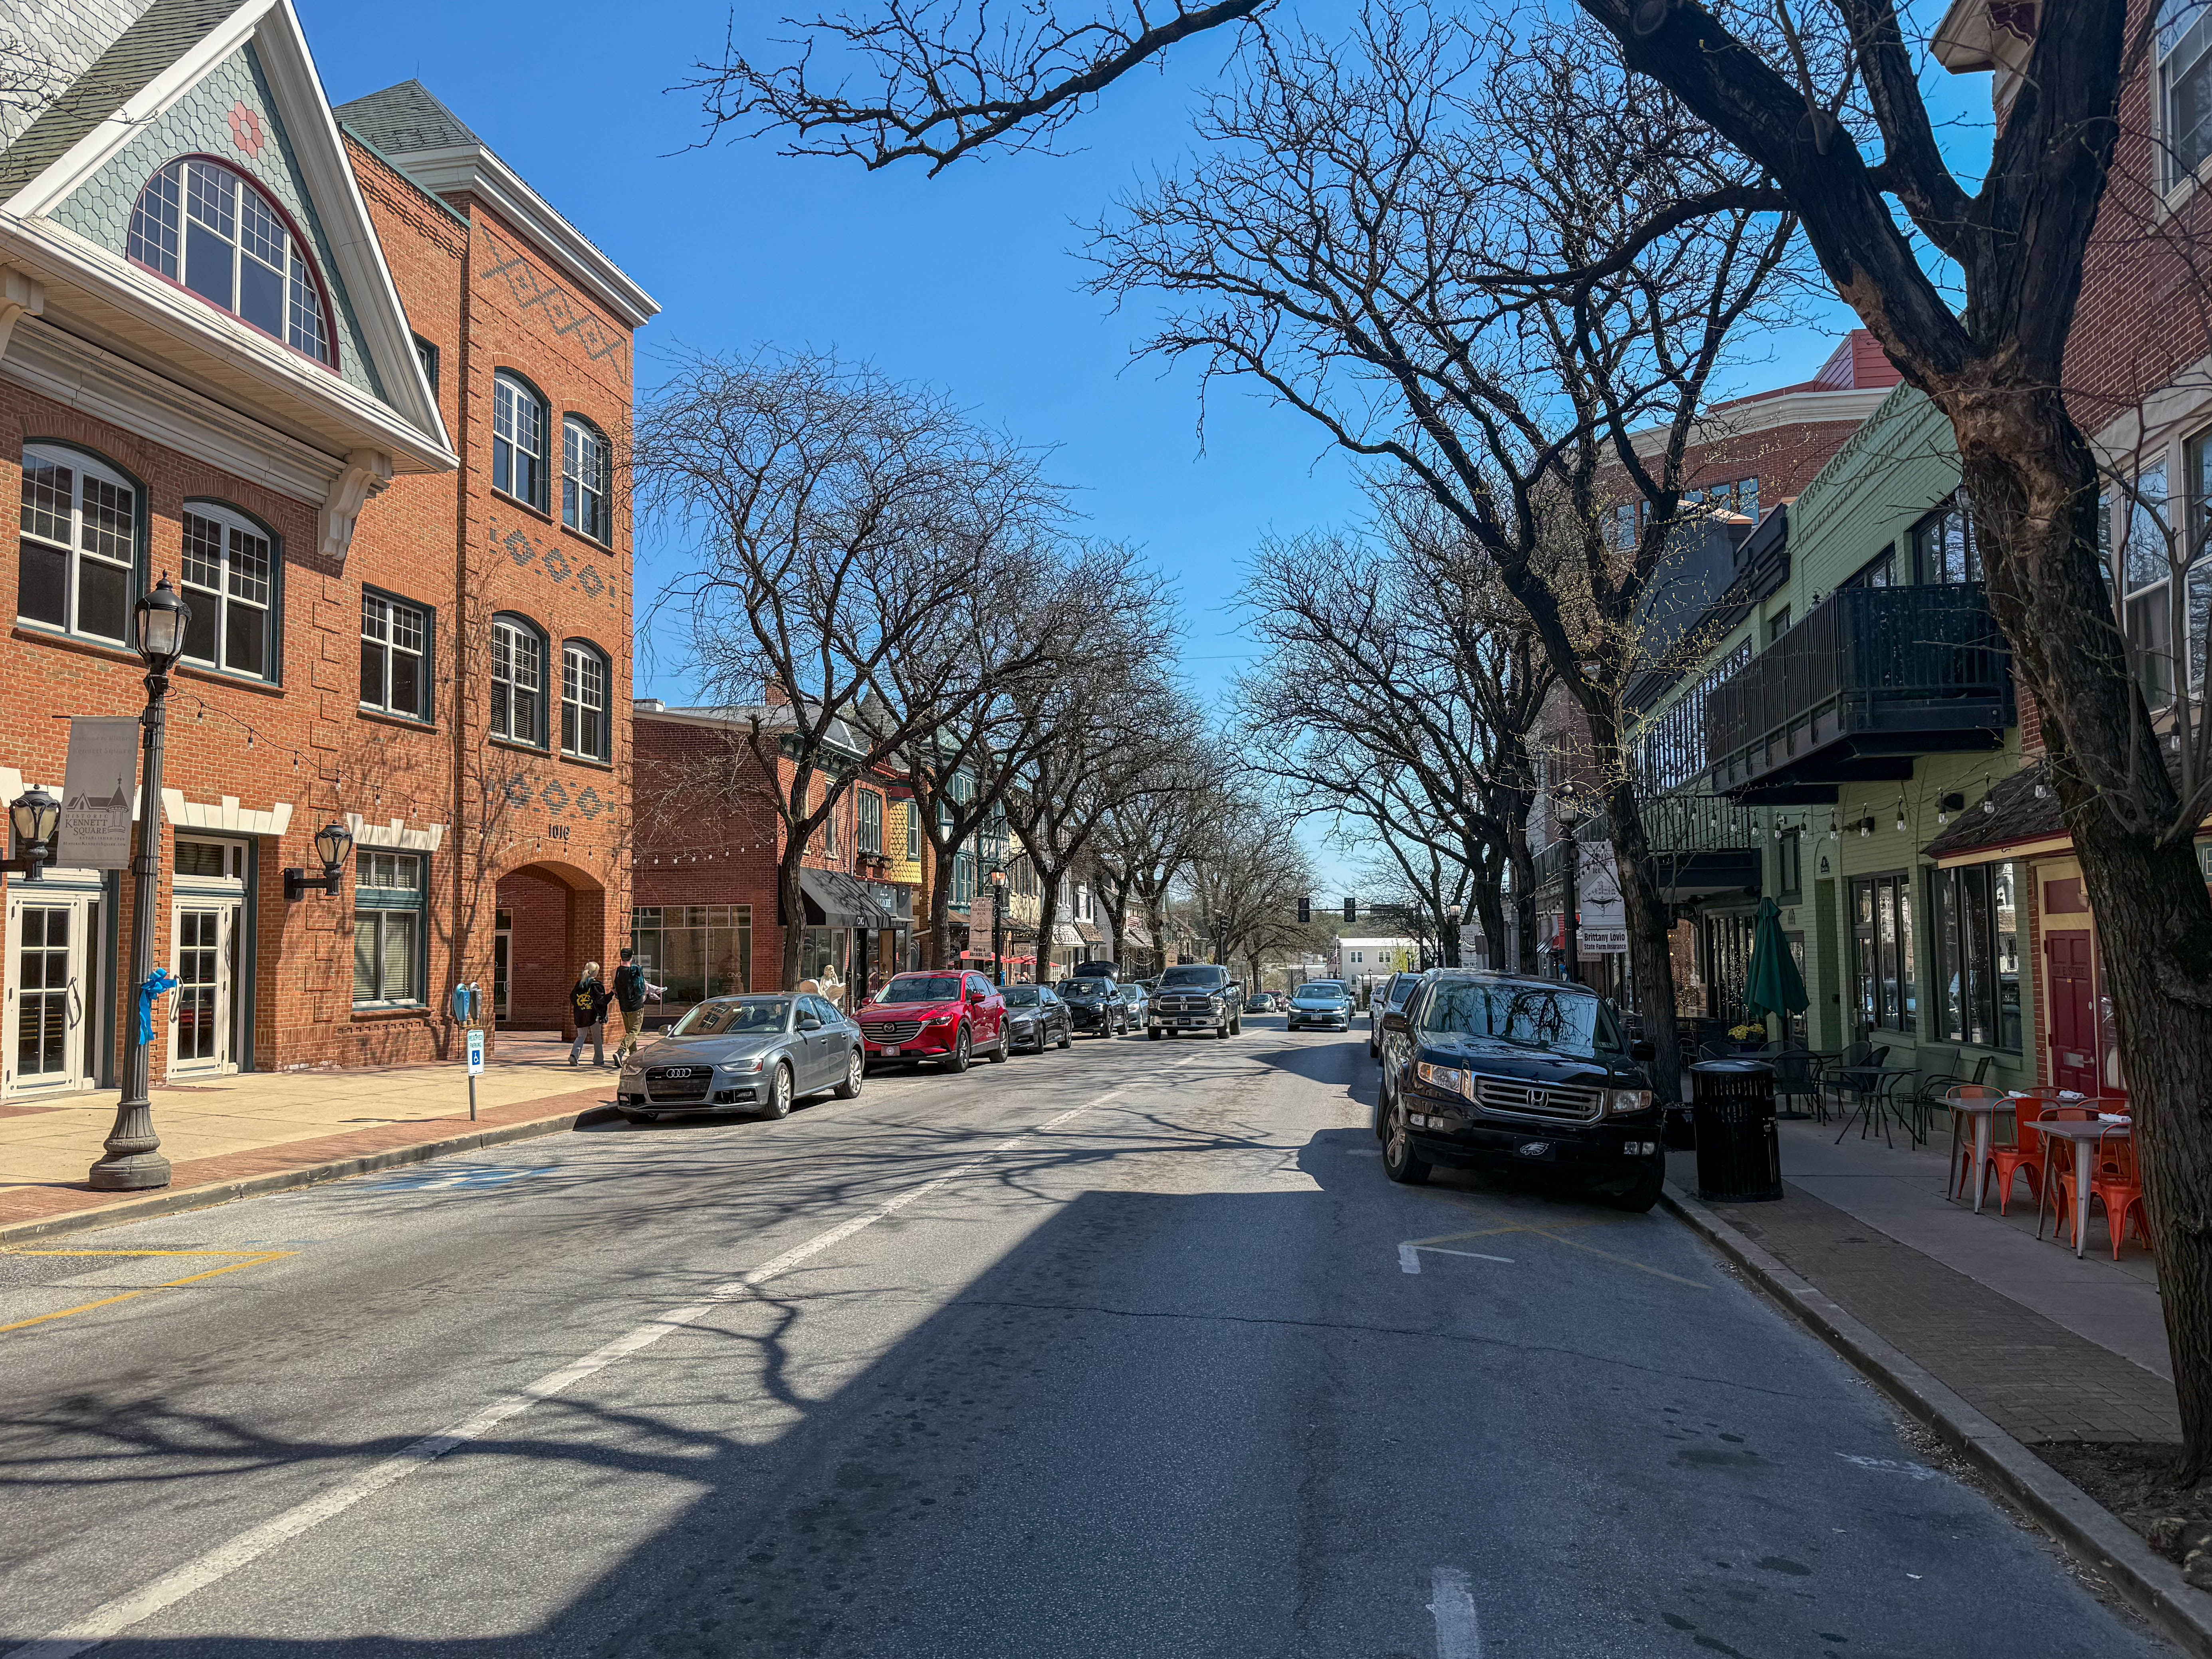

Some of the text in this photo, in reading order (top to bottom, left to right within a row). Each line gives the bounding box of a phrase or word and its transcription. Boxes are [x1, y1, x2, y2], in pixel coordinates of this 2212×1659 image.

[65, 819, 108, 828] KENNETT
[73, 827, 107, 836] SQUARE
[1584, 932, 1625, 943] Brittany Lovio
